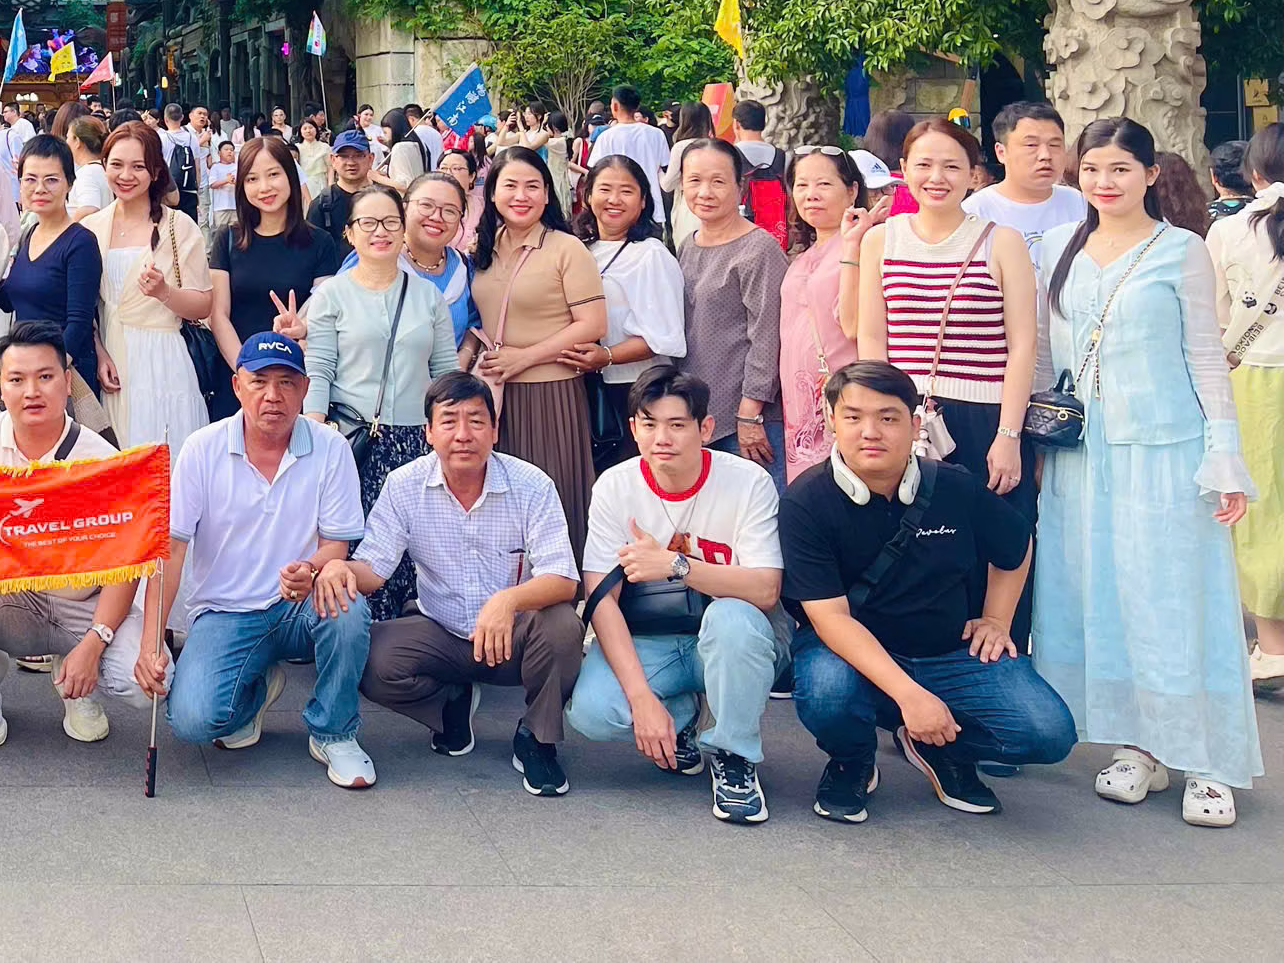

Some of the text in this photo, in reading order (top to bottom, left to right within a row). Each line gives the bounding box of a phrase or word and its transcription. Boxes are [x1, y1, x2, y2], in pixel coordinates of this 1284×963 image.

[258, 341, 293, 355] RVCA
[3, 511, 134, 537] TRAVEL GROUP
[37, 538, 58, 547] BEST
[68, 533, 89, 543] YOUR
[89, 531, 117, 540] CHOICE
